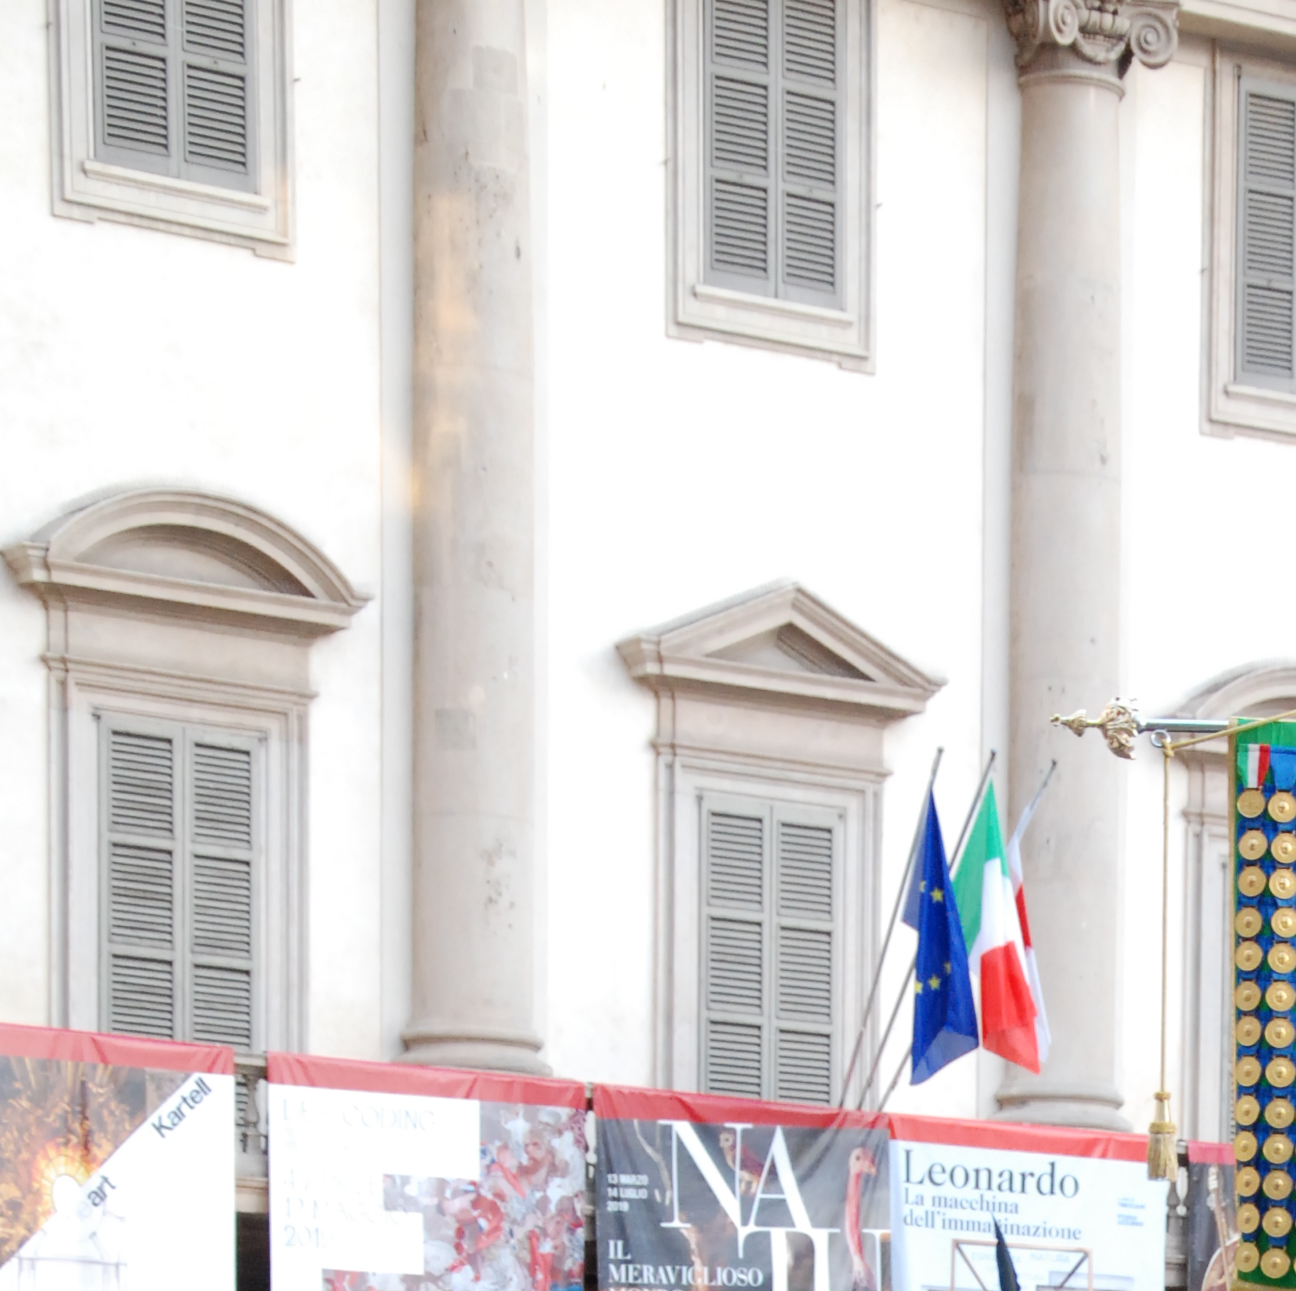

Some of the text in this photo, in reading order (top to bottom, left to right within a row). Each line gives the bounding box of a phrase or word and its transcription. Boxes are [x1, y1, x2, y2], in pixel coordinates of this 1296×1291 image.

[151, 1076, 213, 1139] Kartell
[903, 1148, 1080, 1199] Leonardo
[904, 1187, 1019, 1215] La macchina
[607, 1239, 632, 1260] IL
[607, 1263, 764, 1287] MERAVIGLIOSO
